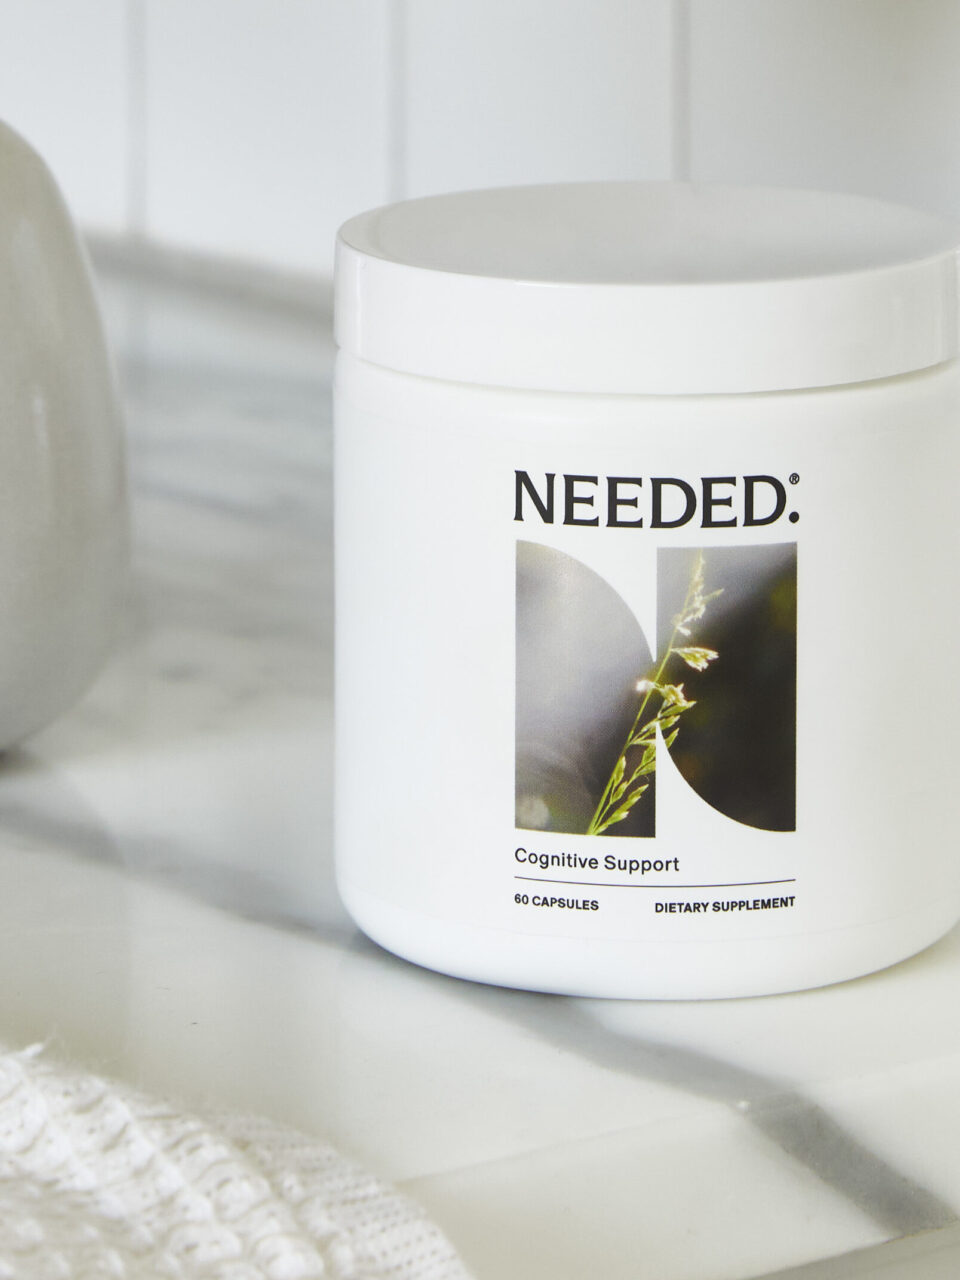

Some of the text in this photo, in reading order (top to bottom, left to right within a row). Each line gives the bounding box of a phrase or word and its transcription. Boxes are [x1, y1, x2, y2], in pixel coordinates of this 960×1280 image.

[514, 847, 680, 876] Cognitive Support
[514, 893, 600, 912] 60 CAPSULES
[654, 895, 796, 914] DIETARY SUPPLEMENT
